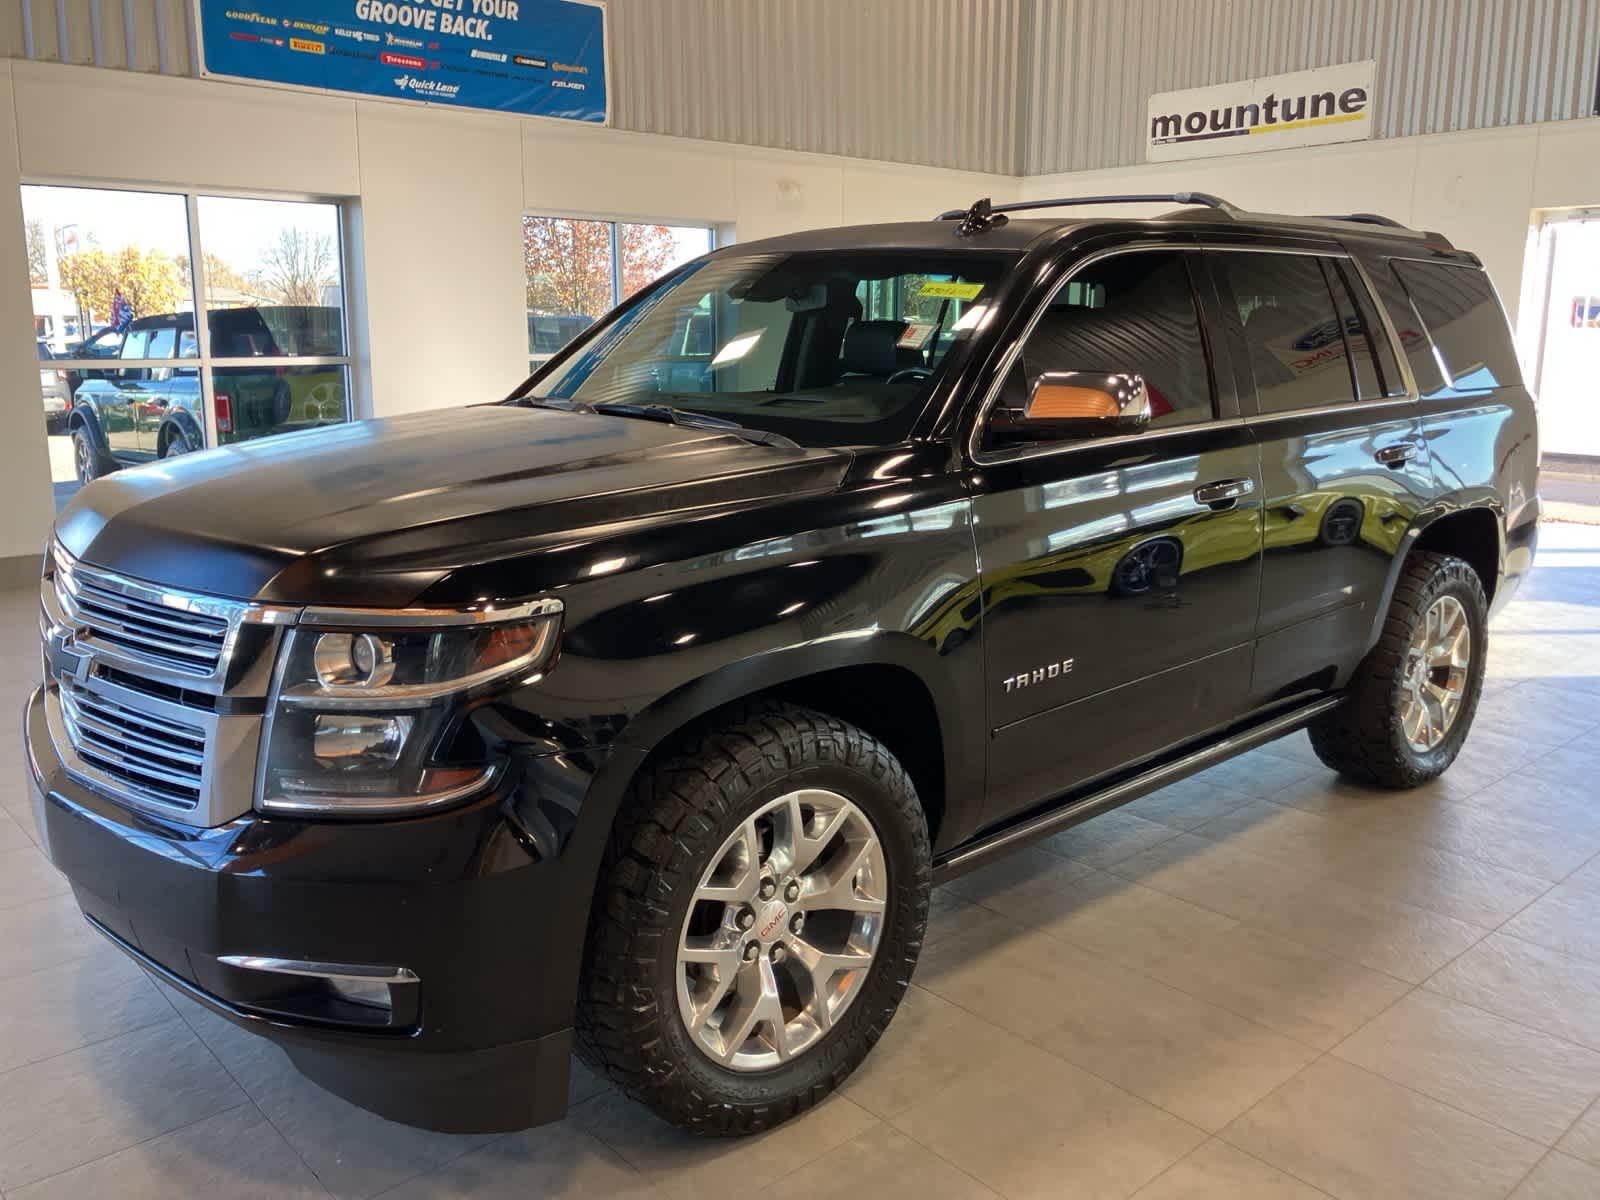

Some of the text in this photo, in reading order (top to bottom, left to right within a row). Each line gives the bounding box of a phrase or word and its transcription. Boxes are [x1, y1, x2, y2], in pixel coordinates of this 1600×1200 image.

[355, 0, 494, 41] GROOVE BACK.
[471, 0, 519, 21] YOUR
[408, 78, 436, 90] Quick
[435, 81, 460, 94] Lane
[1151, 87, 1368, 138] mountune
[1003, 658, 1075, 693] TAHOE
[760, 906, 787, 937] GMC
